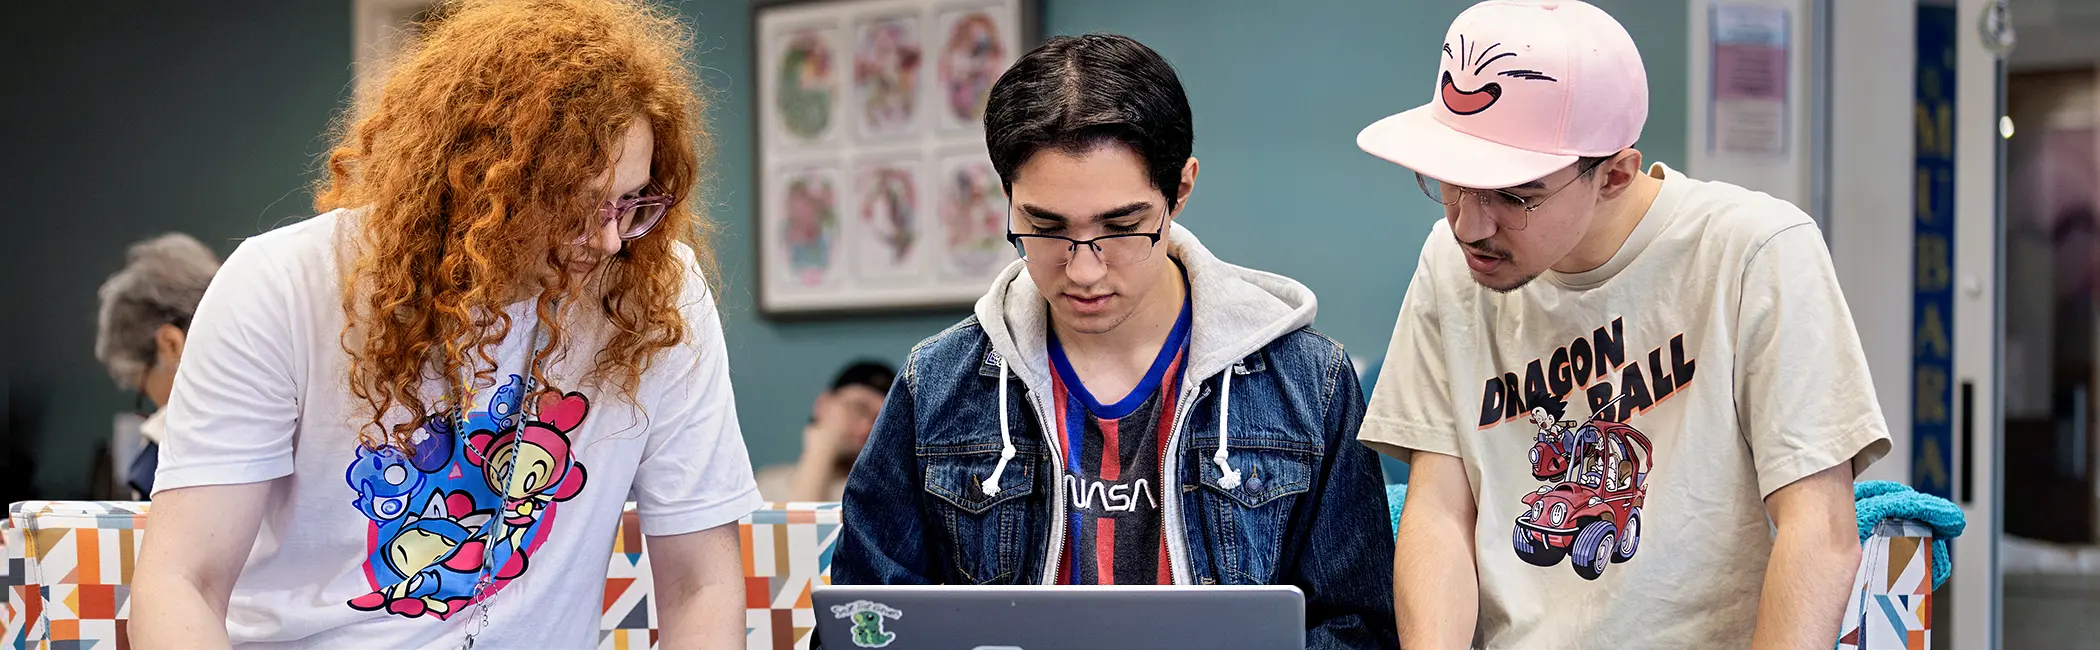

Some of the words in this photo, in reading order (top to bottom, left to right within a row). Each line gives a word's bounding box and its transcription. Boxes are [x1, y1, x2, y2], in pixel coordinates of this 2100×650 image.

[1916, 103, 1952, 488] MUBARA
[1478, 316, 1625, 430] DRAGON
[1586, 333, 1696, 423] BALL
[1064, 475, 1158, 512] NASA
